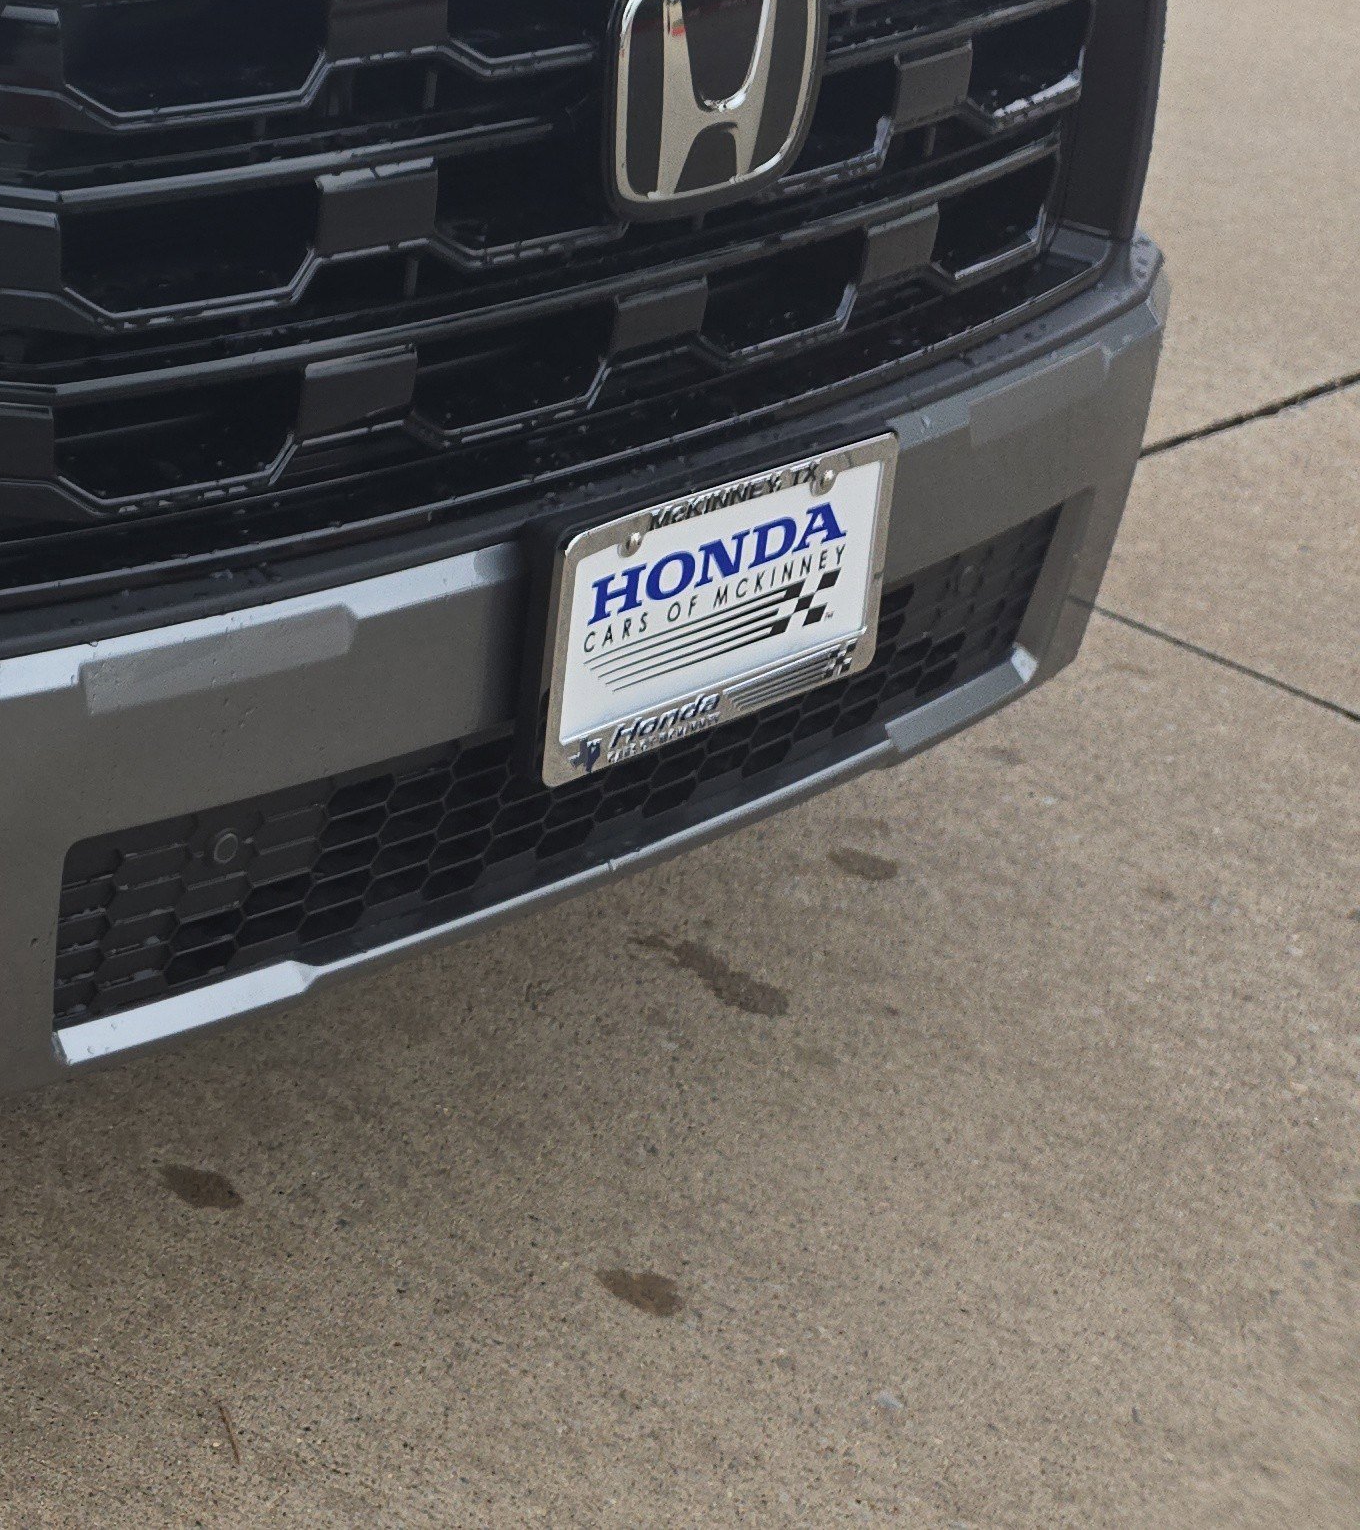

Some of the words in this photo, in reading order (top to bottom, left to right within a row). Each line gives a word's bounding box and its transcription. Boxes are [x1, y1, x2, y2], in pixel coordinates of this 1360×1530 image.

[583, 611, 648, 653] CARS
[667, 594, 700, 621] OF
[713, 543, 847, 609] MCKINNEY
[587, 501, 848, 626] HONDA
[609, 693, 720, 748] Honda
